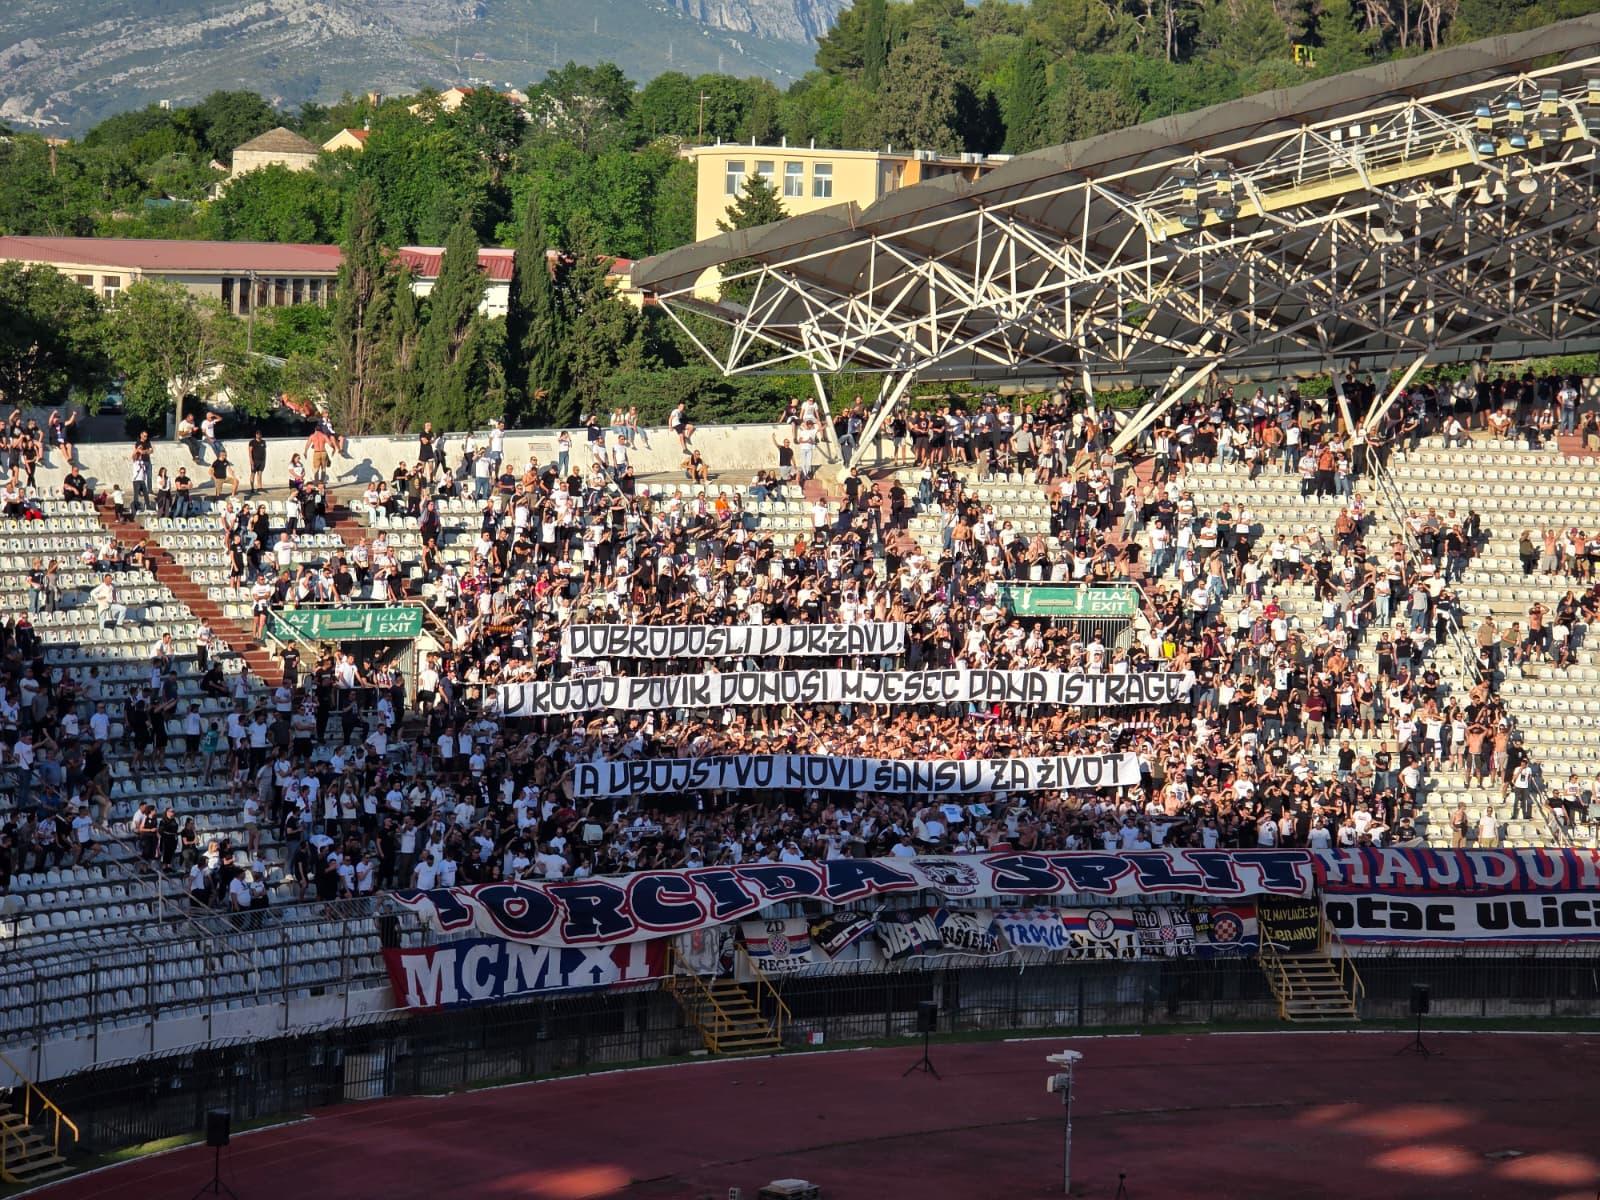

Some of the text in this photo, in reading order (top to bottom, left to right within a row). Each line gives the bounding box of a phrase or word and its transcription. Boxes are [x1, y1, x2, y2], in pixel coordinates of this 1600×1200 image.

[1088, 591, 1130, 600] IZLAZ
[1092, 602, 1125, 611] EXIT
[379, 622, 411, 633] EXIT
[760, 627, 781, 654] U
[788, 623, 903, 653] DRŽAVU,
[502, 685, 525, 714] U
[533, 678, 619, 712] KOJOJ
[628, 674, 711, 708] POVIK
[720, 671, 828, 702] DONOSI
[841, 671, 960, 701] MJESEC
[969, 672, 1048, 701] DANA
[580, 754, 1124, 795] A UBOJSTVO NOVU ŠANSU ZA ŽIVOT
[981, 849, 1314, 896] SPLIT
[1325, 896, 1455, 931] otac
[401, 940, 651, 1007] MCMXI
